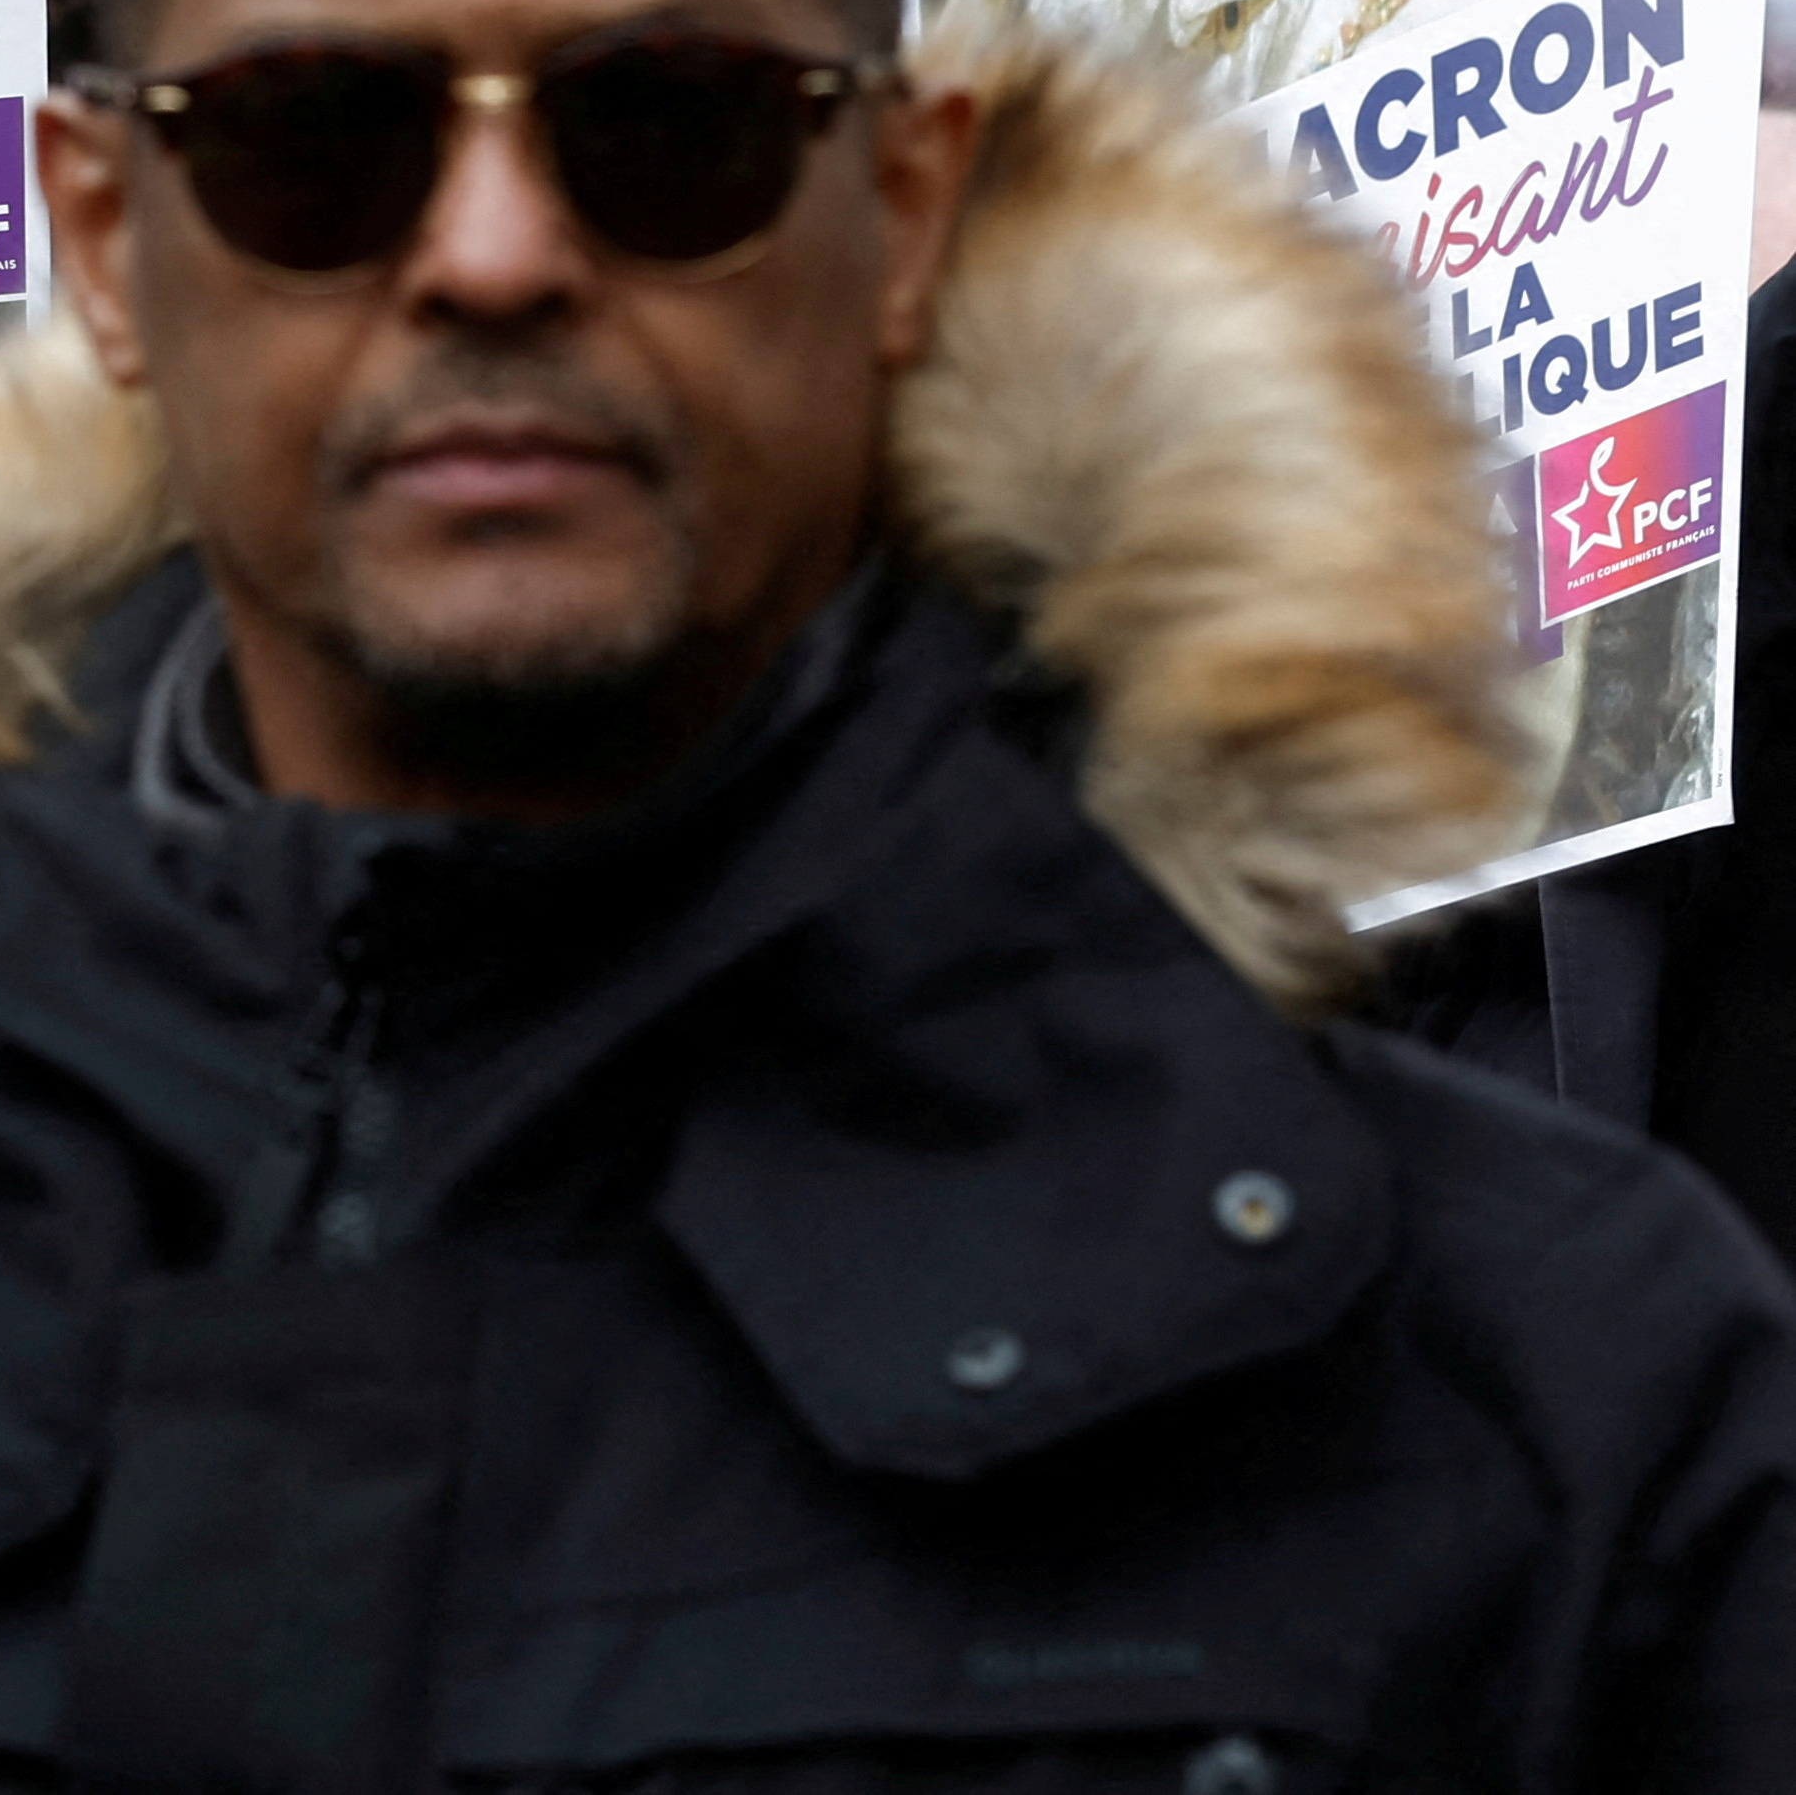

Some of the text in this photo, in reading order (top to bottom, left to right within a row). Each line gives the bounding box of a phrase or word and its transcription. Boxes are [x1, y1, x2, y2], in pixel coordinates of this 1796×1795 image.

[1452, 261, 1553, 359] LA
[1633, 477, 1713, 545] PCF
[1567, 524, 1716, 591] PARTI COMMUNISTE FRANÇAIS
